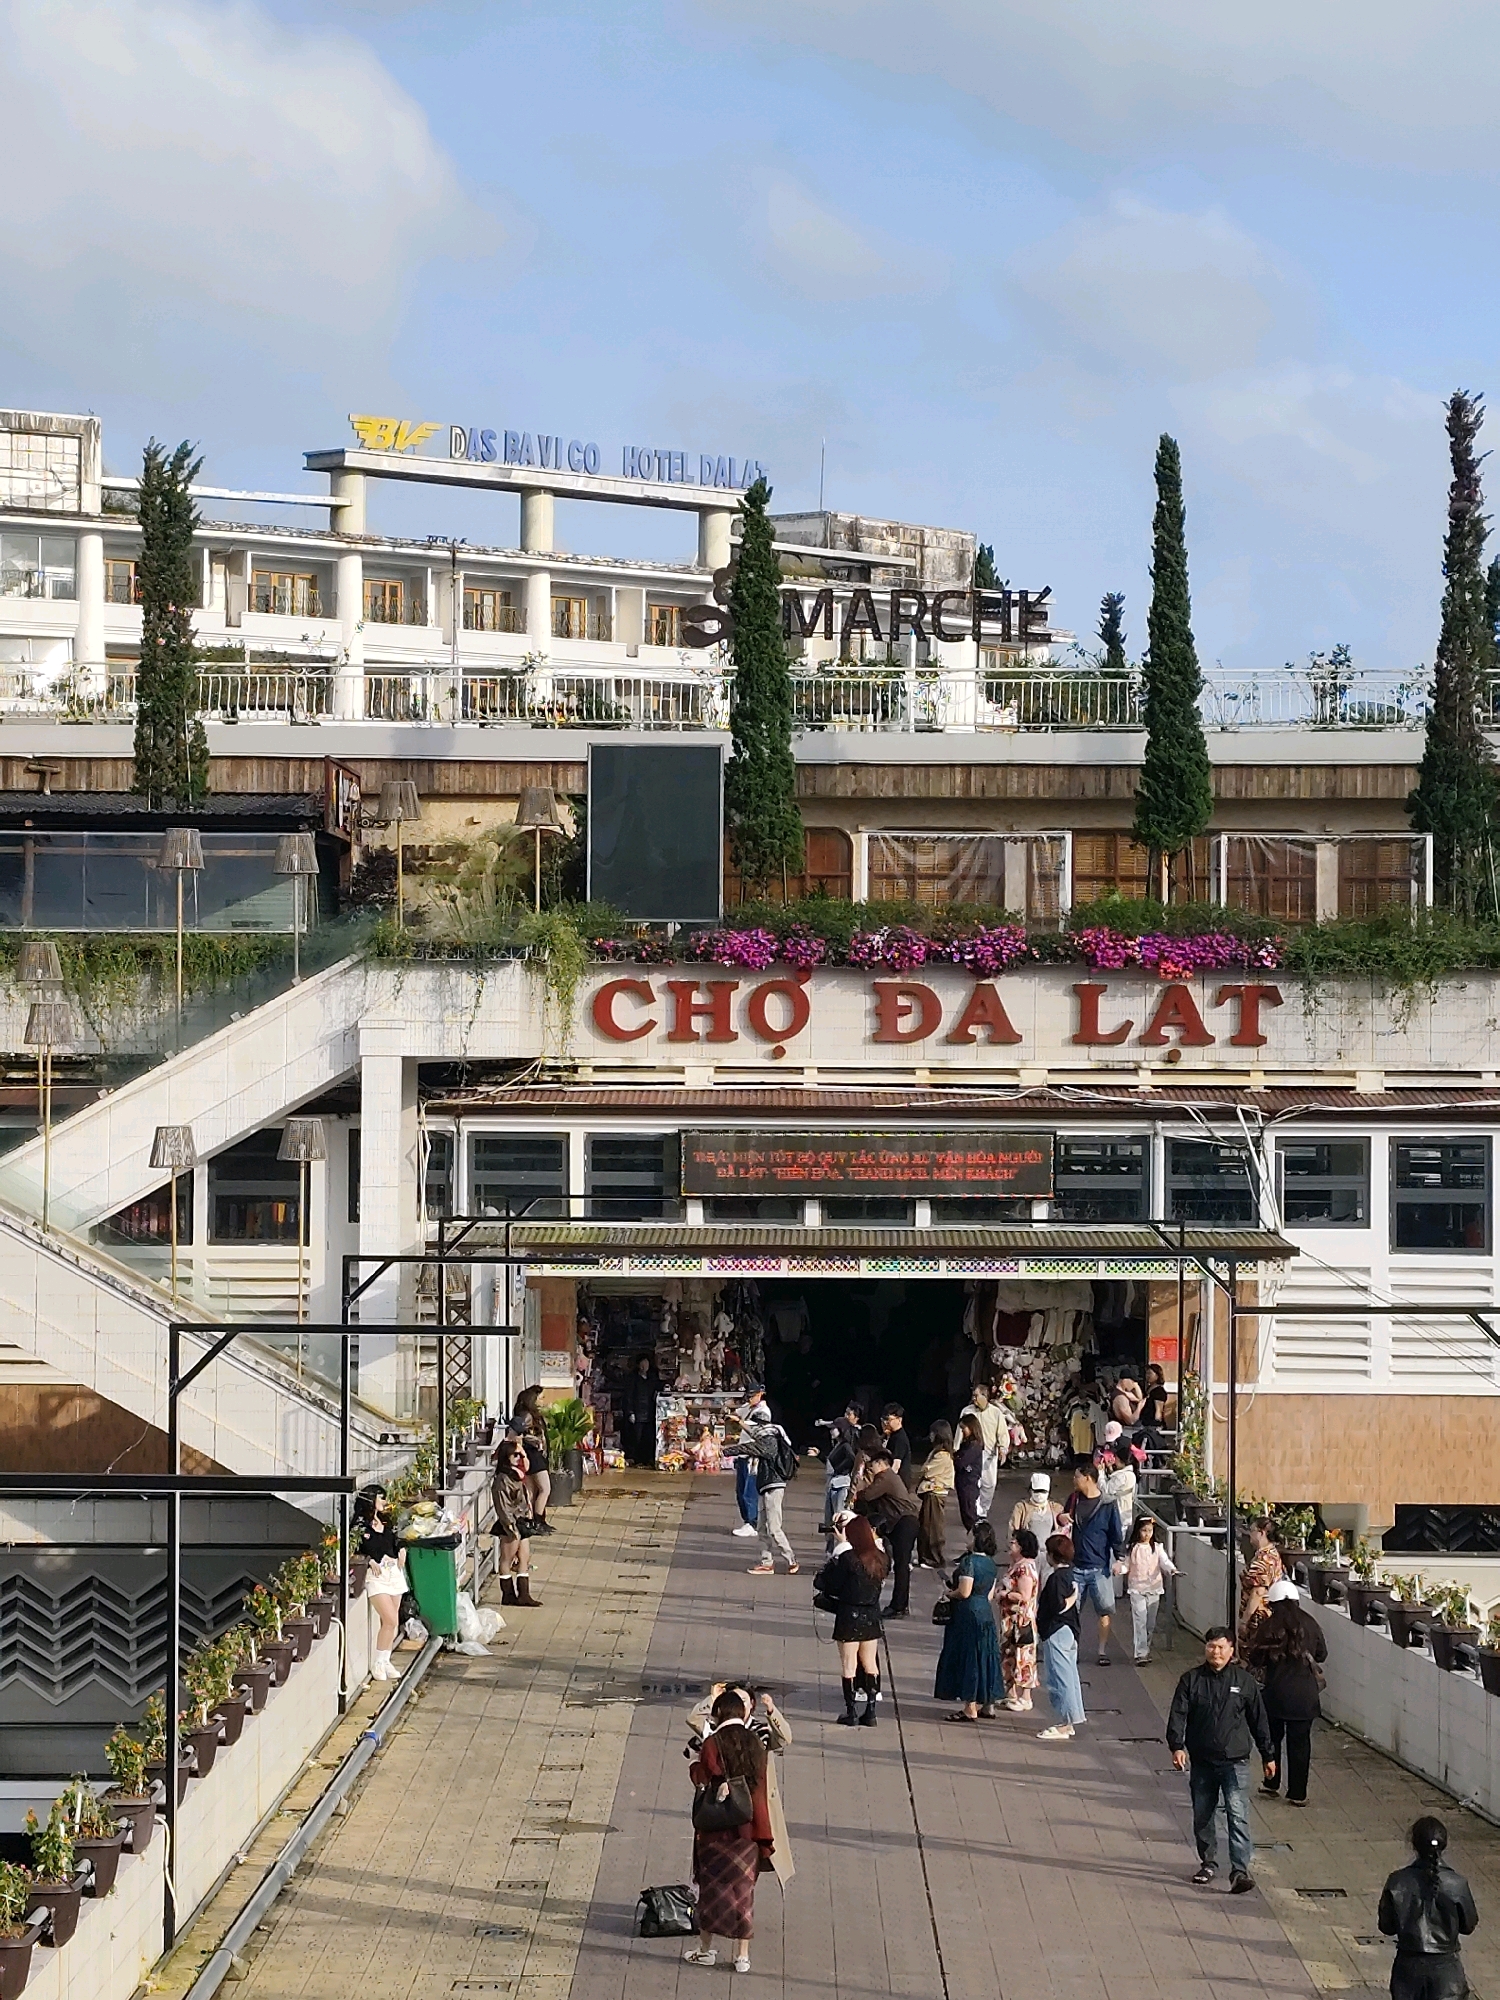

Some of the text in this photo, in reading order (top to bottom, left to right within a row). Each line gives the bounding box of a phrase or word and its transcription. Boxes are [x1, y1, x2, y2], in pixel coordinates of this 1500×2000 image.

[450, 425, 497, 462] DAS
[623, 446, 694, 482] HOTEL
[782, 585, 1052, 643] MARCHÉ
[592, 970, 812, 1060] CHỢ
[1072, 983, 1285, 1064] LẠT
